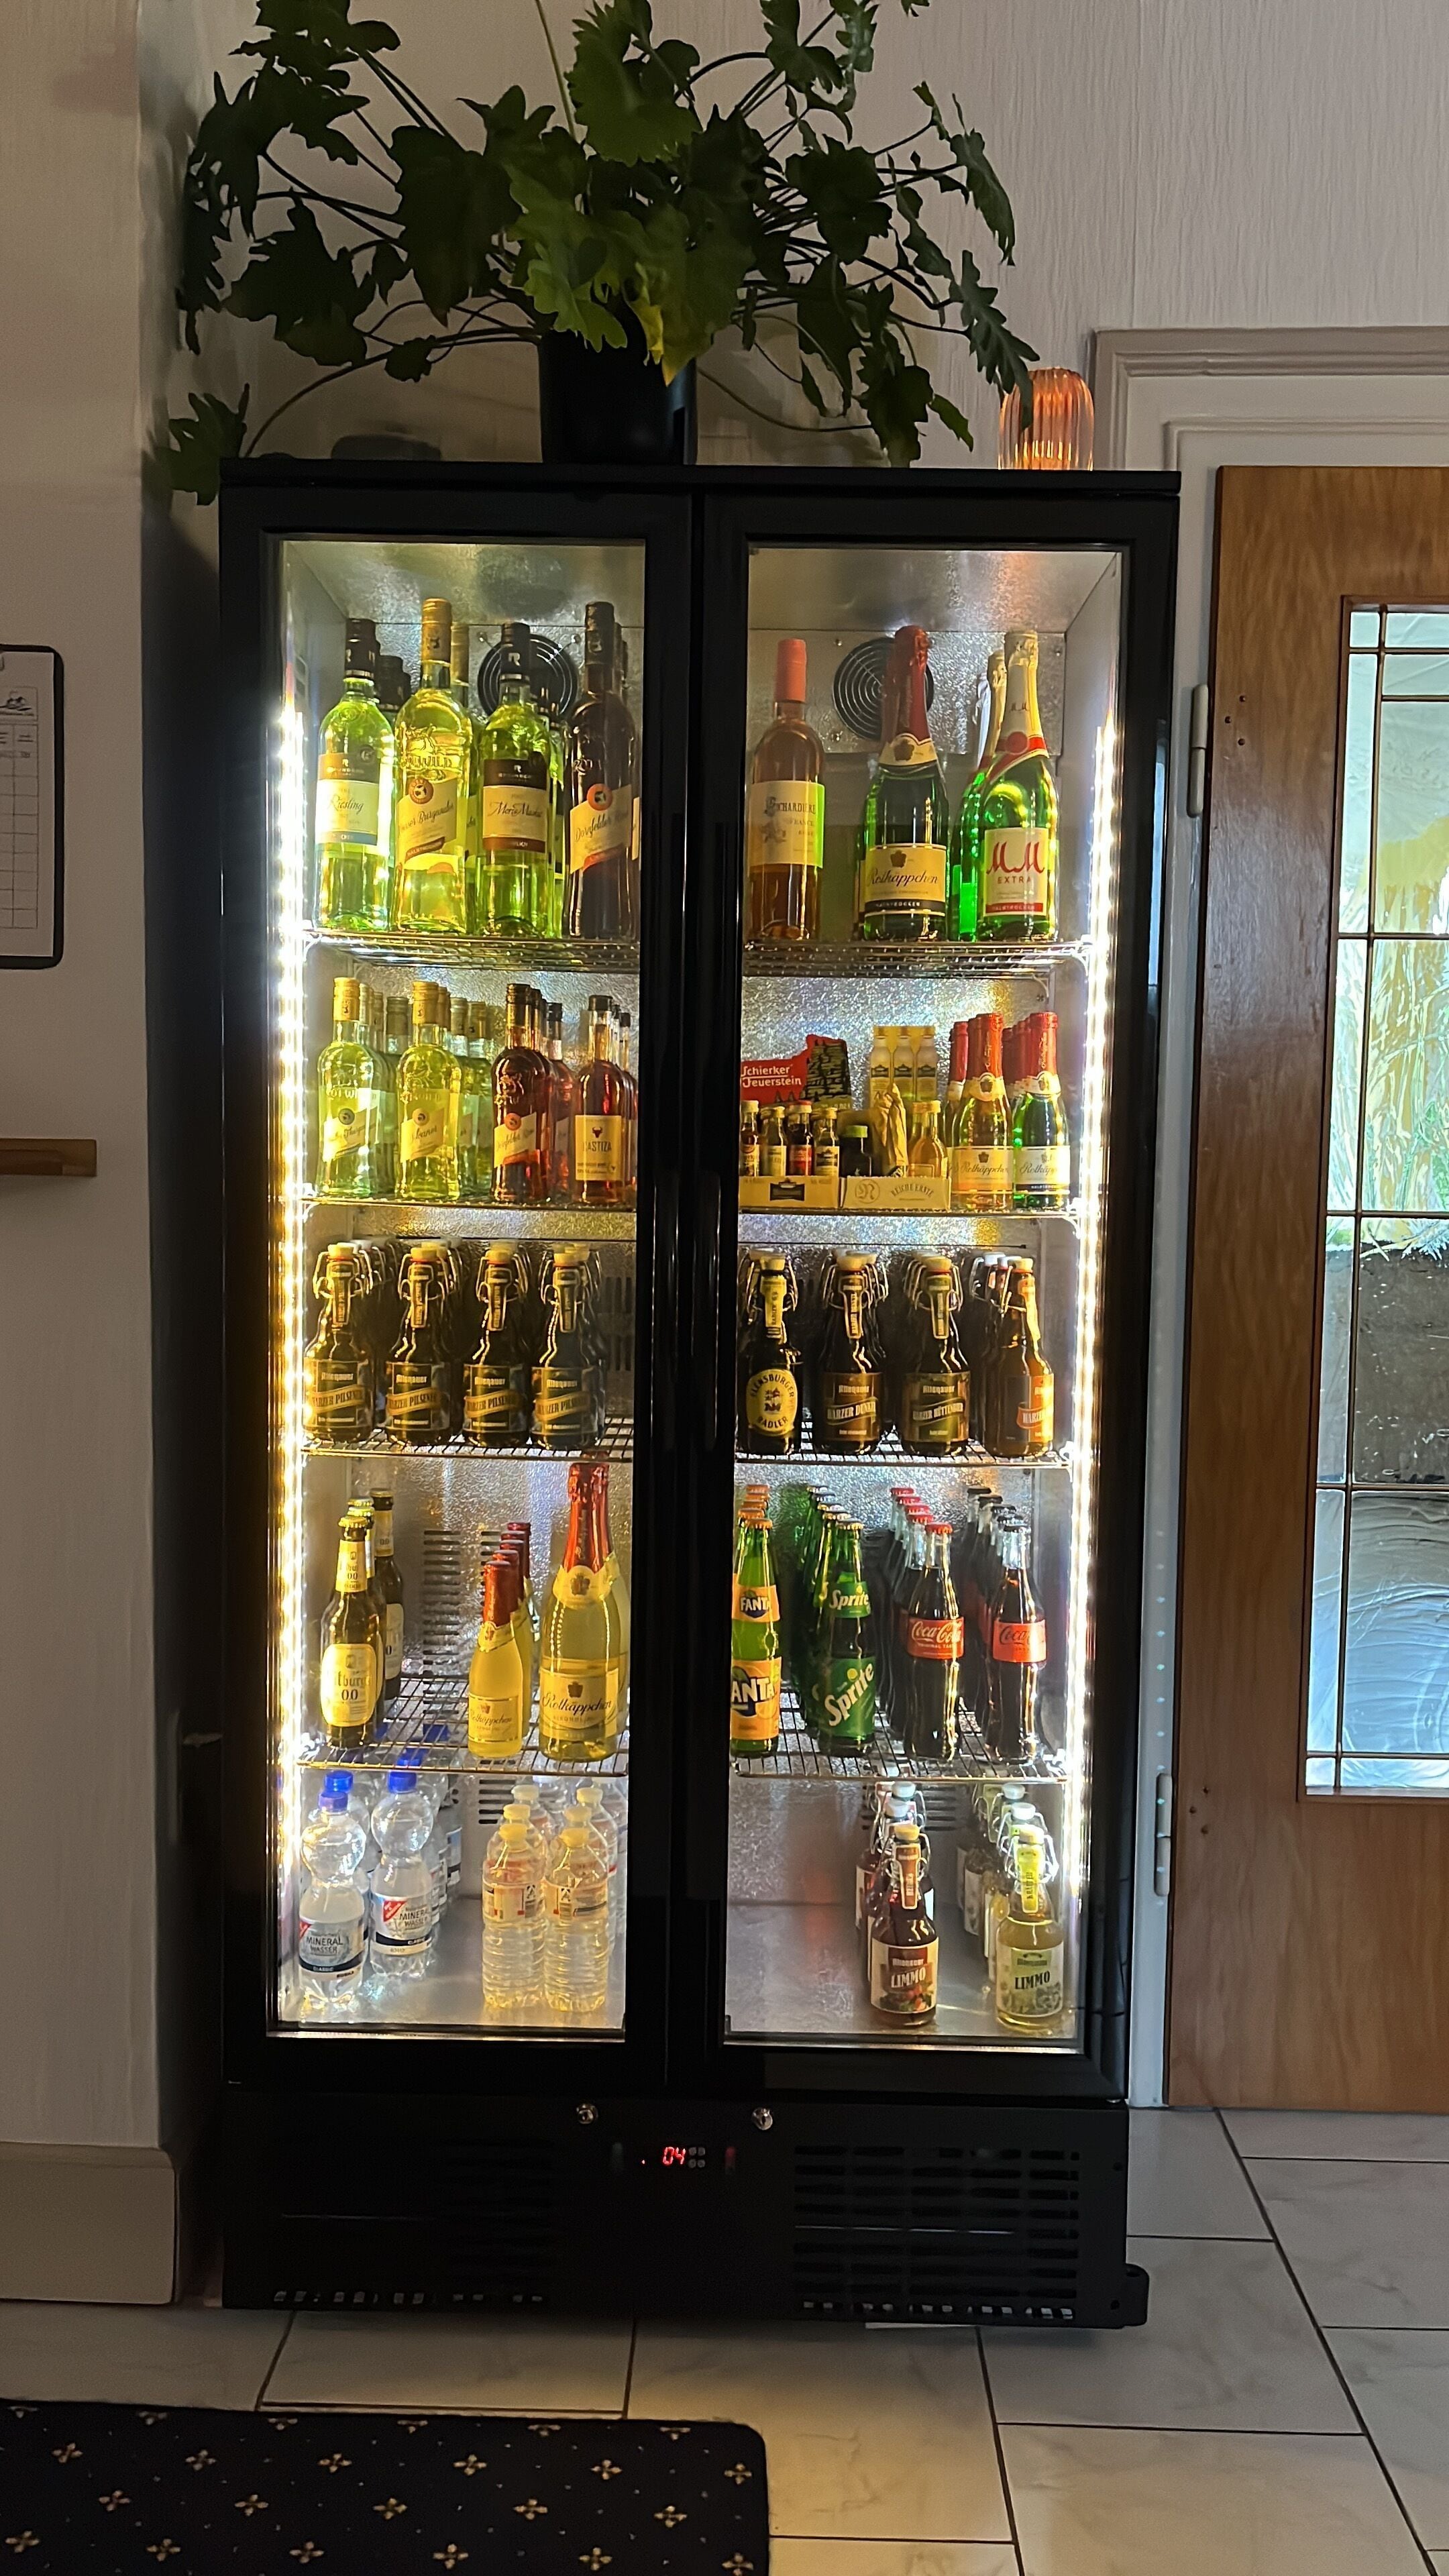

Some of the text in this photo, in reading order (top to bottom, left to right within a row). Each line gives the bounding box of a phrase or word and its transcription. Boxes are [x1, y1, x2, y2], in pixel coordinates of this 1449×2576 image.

[998, 875, 1032, 884] EXTRA
[740, 1065, 790, 1077] Schierker
[742, 1075, 802, 1088] Feuerstein
[758, 1415, 788, 1428] RADLER
[740, 1597, 771, 1611] FANTA
[829, 1589, 869, 1609] Sprite
[731, 1677, 775, 1703] ANTA
[824, 1663, 874, 1727] Sprite
[399, 1909, 428, 1920] MINERA
[306, 1933, 343, 1946] MINERAL
[311, 1945, 337, 1954] WASSER
[891, 1967, 926, 1988] LIMMO
[1015, 1970, 1051, 1990] LIMMO
[663, 2147, 686, 2165] 04
